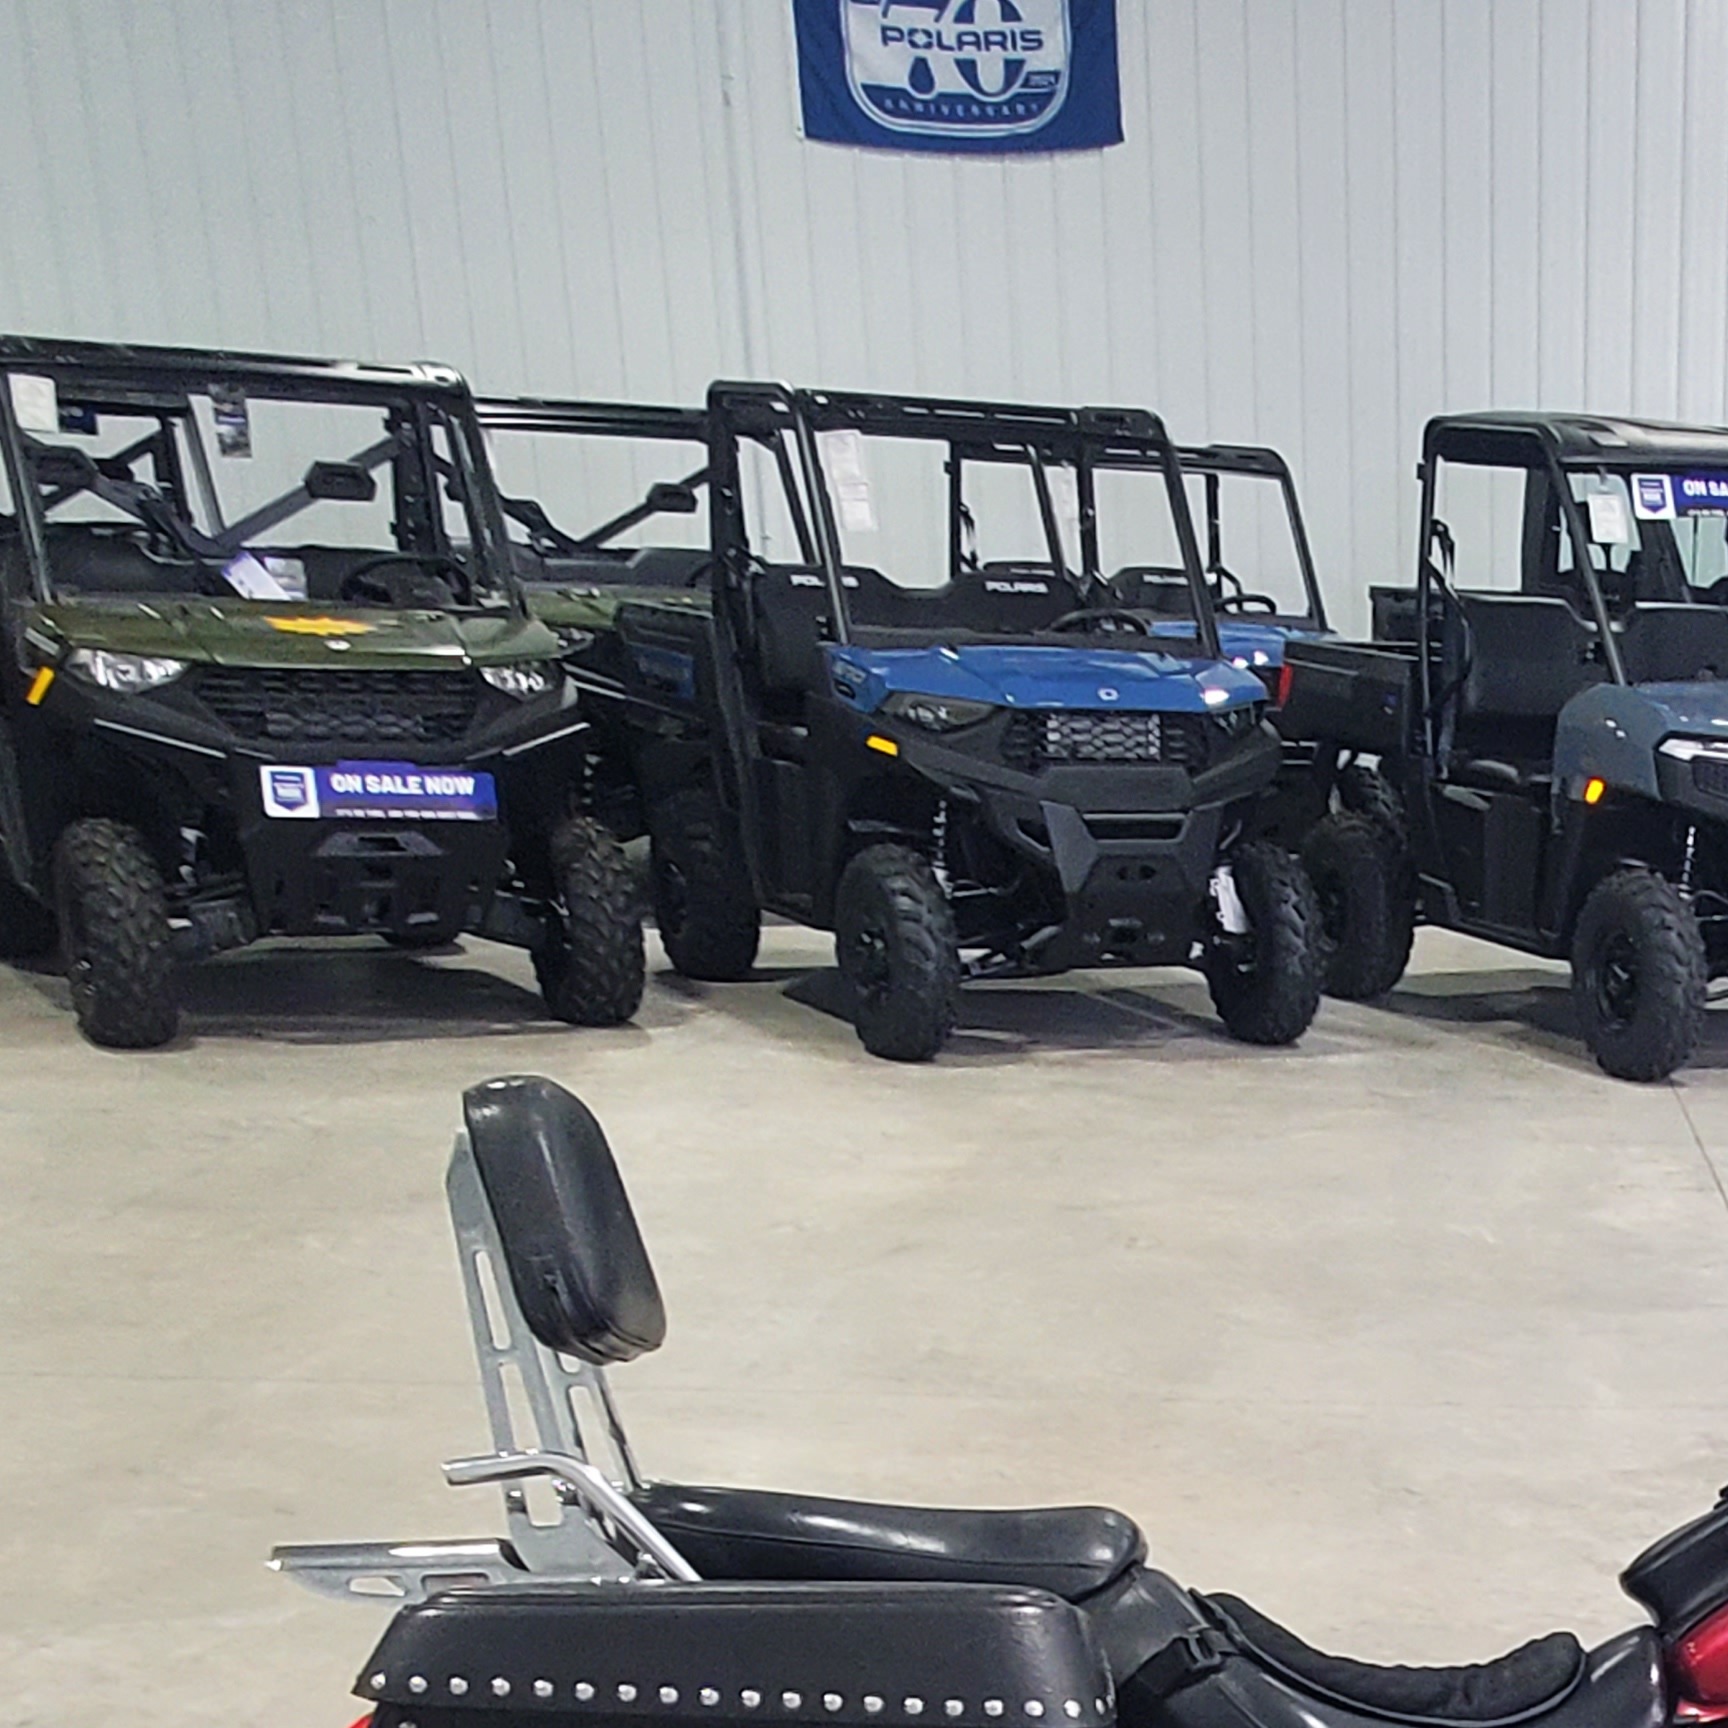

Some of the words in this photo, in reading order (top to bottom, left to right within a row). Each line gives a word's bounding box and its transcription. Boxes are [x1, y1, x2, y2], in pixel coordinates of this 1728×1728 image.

[880, 25, 1044, 52] POLARIS
[1682, 479, 1707, 497] ON
[985, 581, 1049, 593] POLARIS
[329, 772, 363, 794] ON
[366, 774, 424, 795] SALE
[425, 776, 476, 796] NOW
